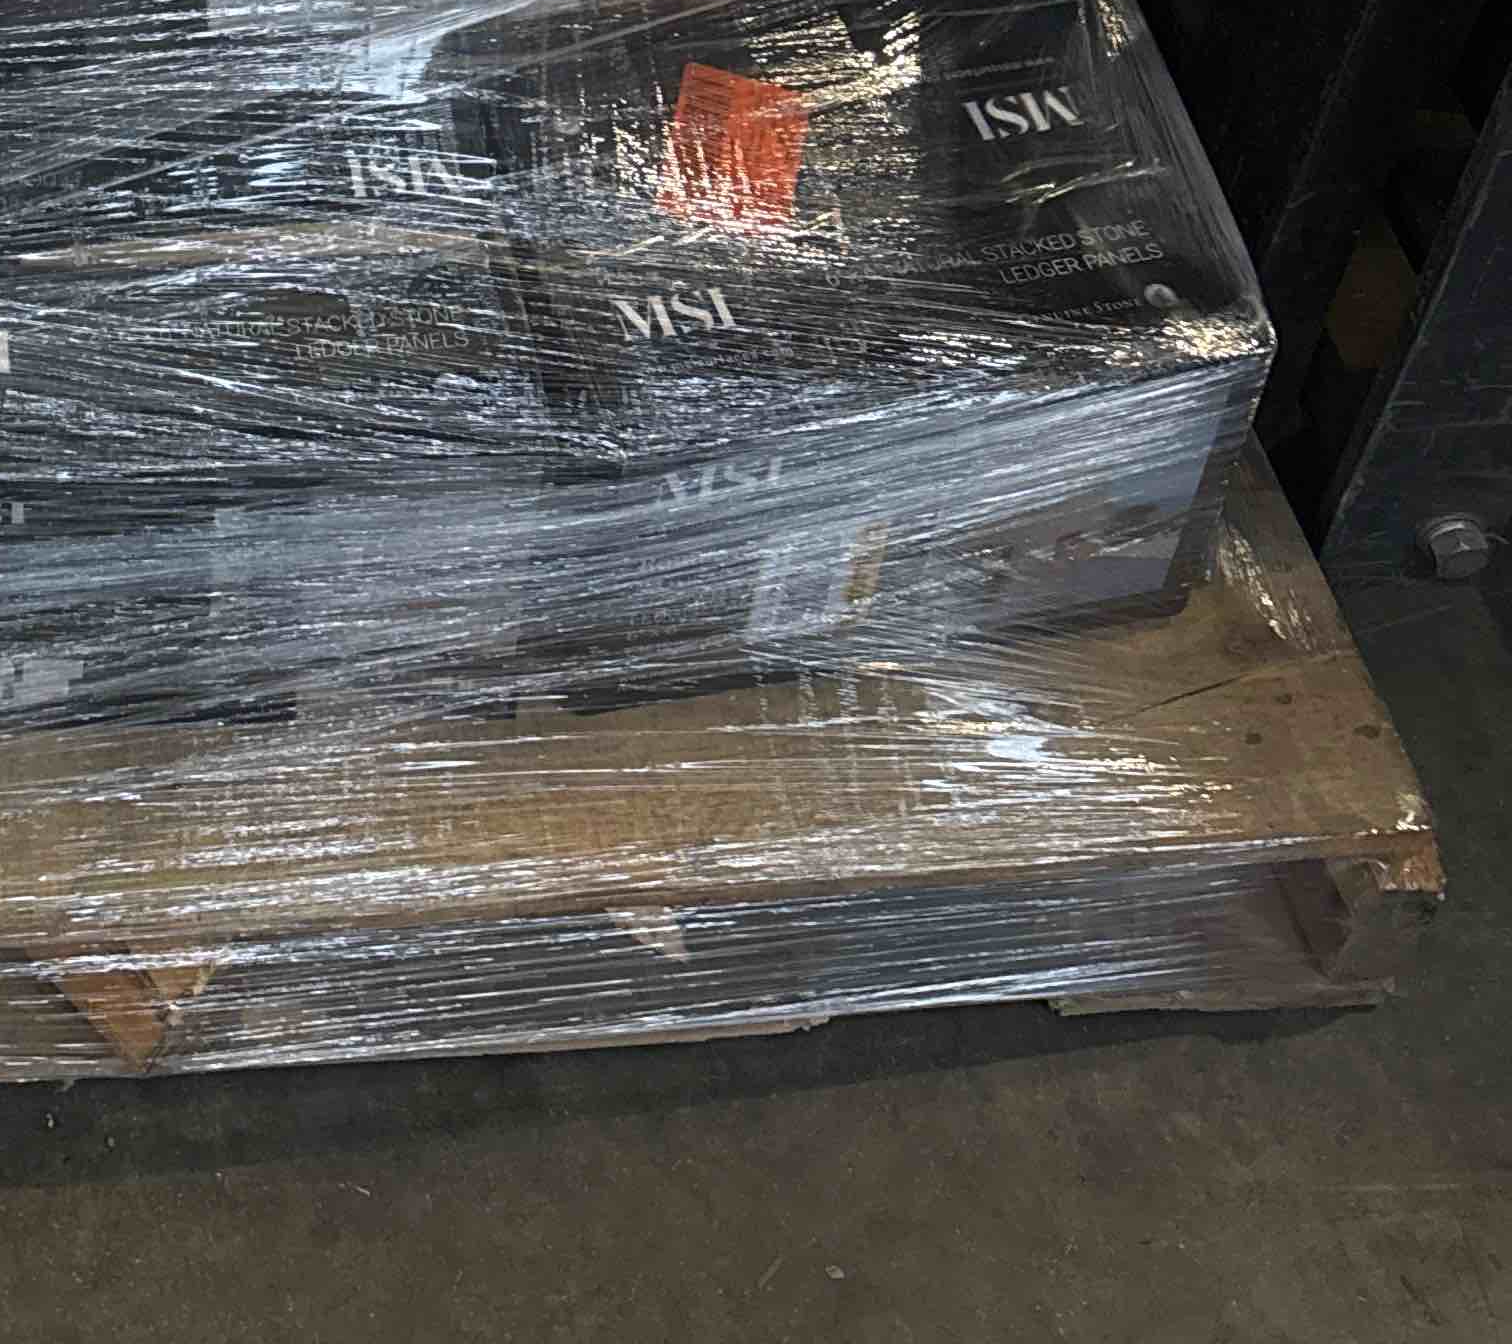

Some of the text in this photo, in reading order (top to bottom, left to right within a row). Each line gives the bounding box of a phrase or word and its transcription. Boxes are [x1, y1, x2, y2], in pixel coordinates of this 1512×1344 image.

[960, 84, 1087, 141] MSI
[346, 145, 468, 201] MSI
[982, 232, 1076, 263] STACKED
[1079, 219, 1153, 248] STONE
[998, 242, 1165, 286] LEDGER PANELS
[608, 286, 738, 342] MSI
[386, 330, 470, 354] PANELS
